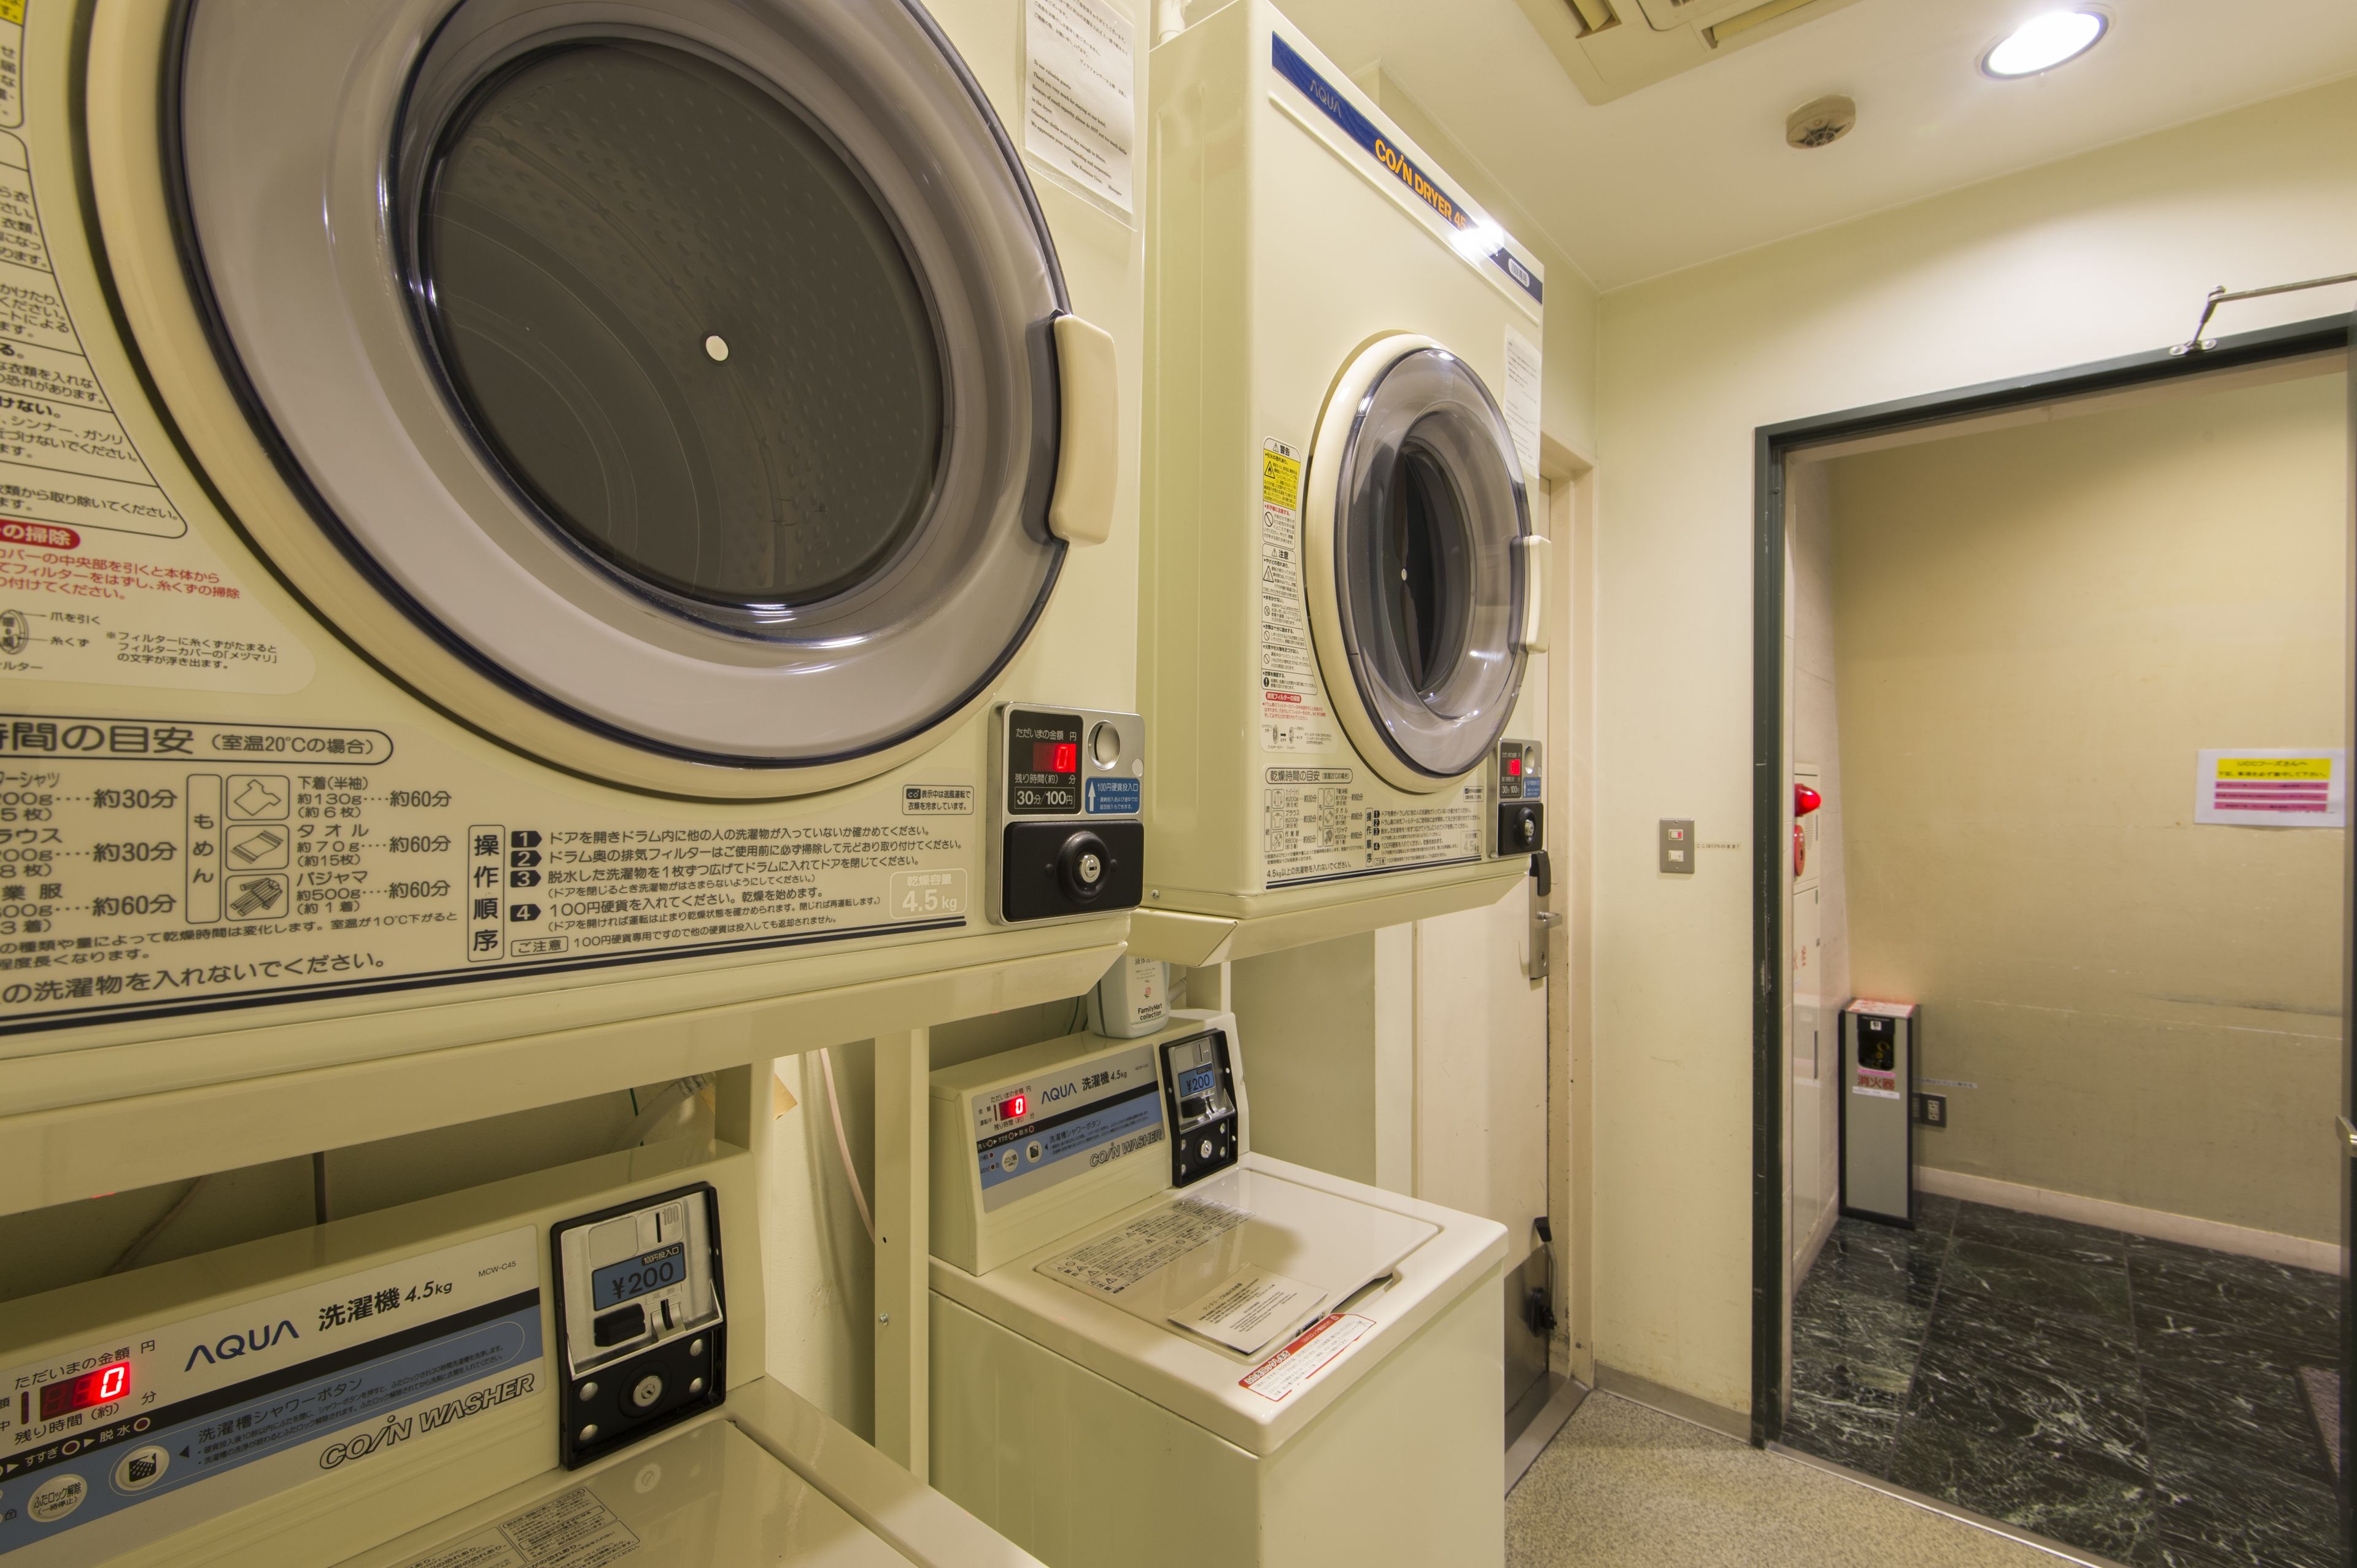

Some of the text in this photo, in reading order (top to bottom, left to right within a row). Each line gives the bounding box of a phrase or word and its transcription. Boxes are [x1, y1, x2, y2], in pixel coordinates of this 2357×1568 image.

[1034, 71, 1045, 83] Thank
[1310, 79, 1342, 118] AQUA
[1415, 172, 1452, 222] DRYER
[1280, 444, 1290, 457] 警告
[1279, 550, 1289, 560] 注意
[50, 611, 101, 625] 爪を引く
[50, 636, 90, 648] 糸くず
[0, 722, 195, 754] 間の目安
[1016, 728, 1064, 741] ただいまの金額
[1056, 745, 1069, 769] 0
[1270, 770, 1320, 781] 乾燥時間の目安
[93, 789, 178, 809] 約30分
[297, 790, 452, 808] 約130g 約60分
[296, 835, 452, 854] 約70g 約60分
[519, 832, 528, 847] 1
[93, 841, 177, 863] 約30分
[517, 851, 530, 867] 2
[296, 870, 368, 887] パジャマ
[517, 871, 530, 887] 3
[296, 879, 451, 902] 約500g 約60分
[473, 834, 500, 952] 操作順序
[92, 894, 177, 917] 約60分
[516, 905, 531, 920] 4
[518, 939, 562, 954] ご注意
[1137, 1003, 1163, 1014] FamilyMart
[1140, 1010, 1162, 1021] collection
[1041, 1082, 1077, 1105] AQUA
[1082, 1072, 1110, 1091] 洗濯機
[1186, 1074, 1210, 1092] ¥200
[1857, 1075, 1895, 1091] 消火器
[1015, 1098, 1023, 1114] 0
[1122, 1129, 1163, 1154] WASHER
[662, 1205, 679, 1226] 100
[643, 1246, 679, 1265] 100円投入口
[478, 1261, 517, 1278] MCW-C45
[613, 1261, 675, 1300] ¥200
[184, 1319, 300, 1373] AQUA
[317, 1287, 401, 1332] 洗濯機
[15, 1339, 156, 1391] ただいまの金額 円
[100, 1366, 125, 1399] 0
[141, 1391, 157, 1405] 分
[419, 1372, 535, 1434] WASHER
[198, 1378, 363, 1444] 洗濯槽シャワーボタン
[25, 1446, 59, 1467] すすぎ
[34, 1482, 82, 1509] ふたロック解除
